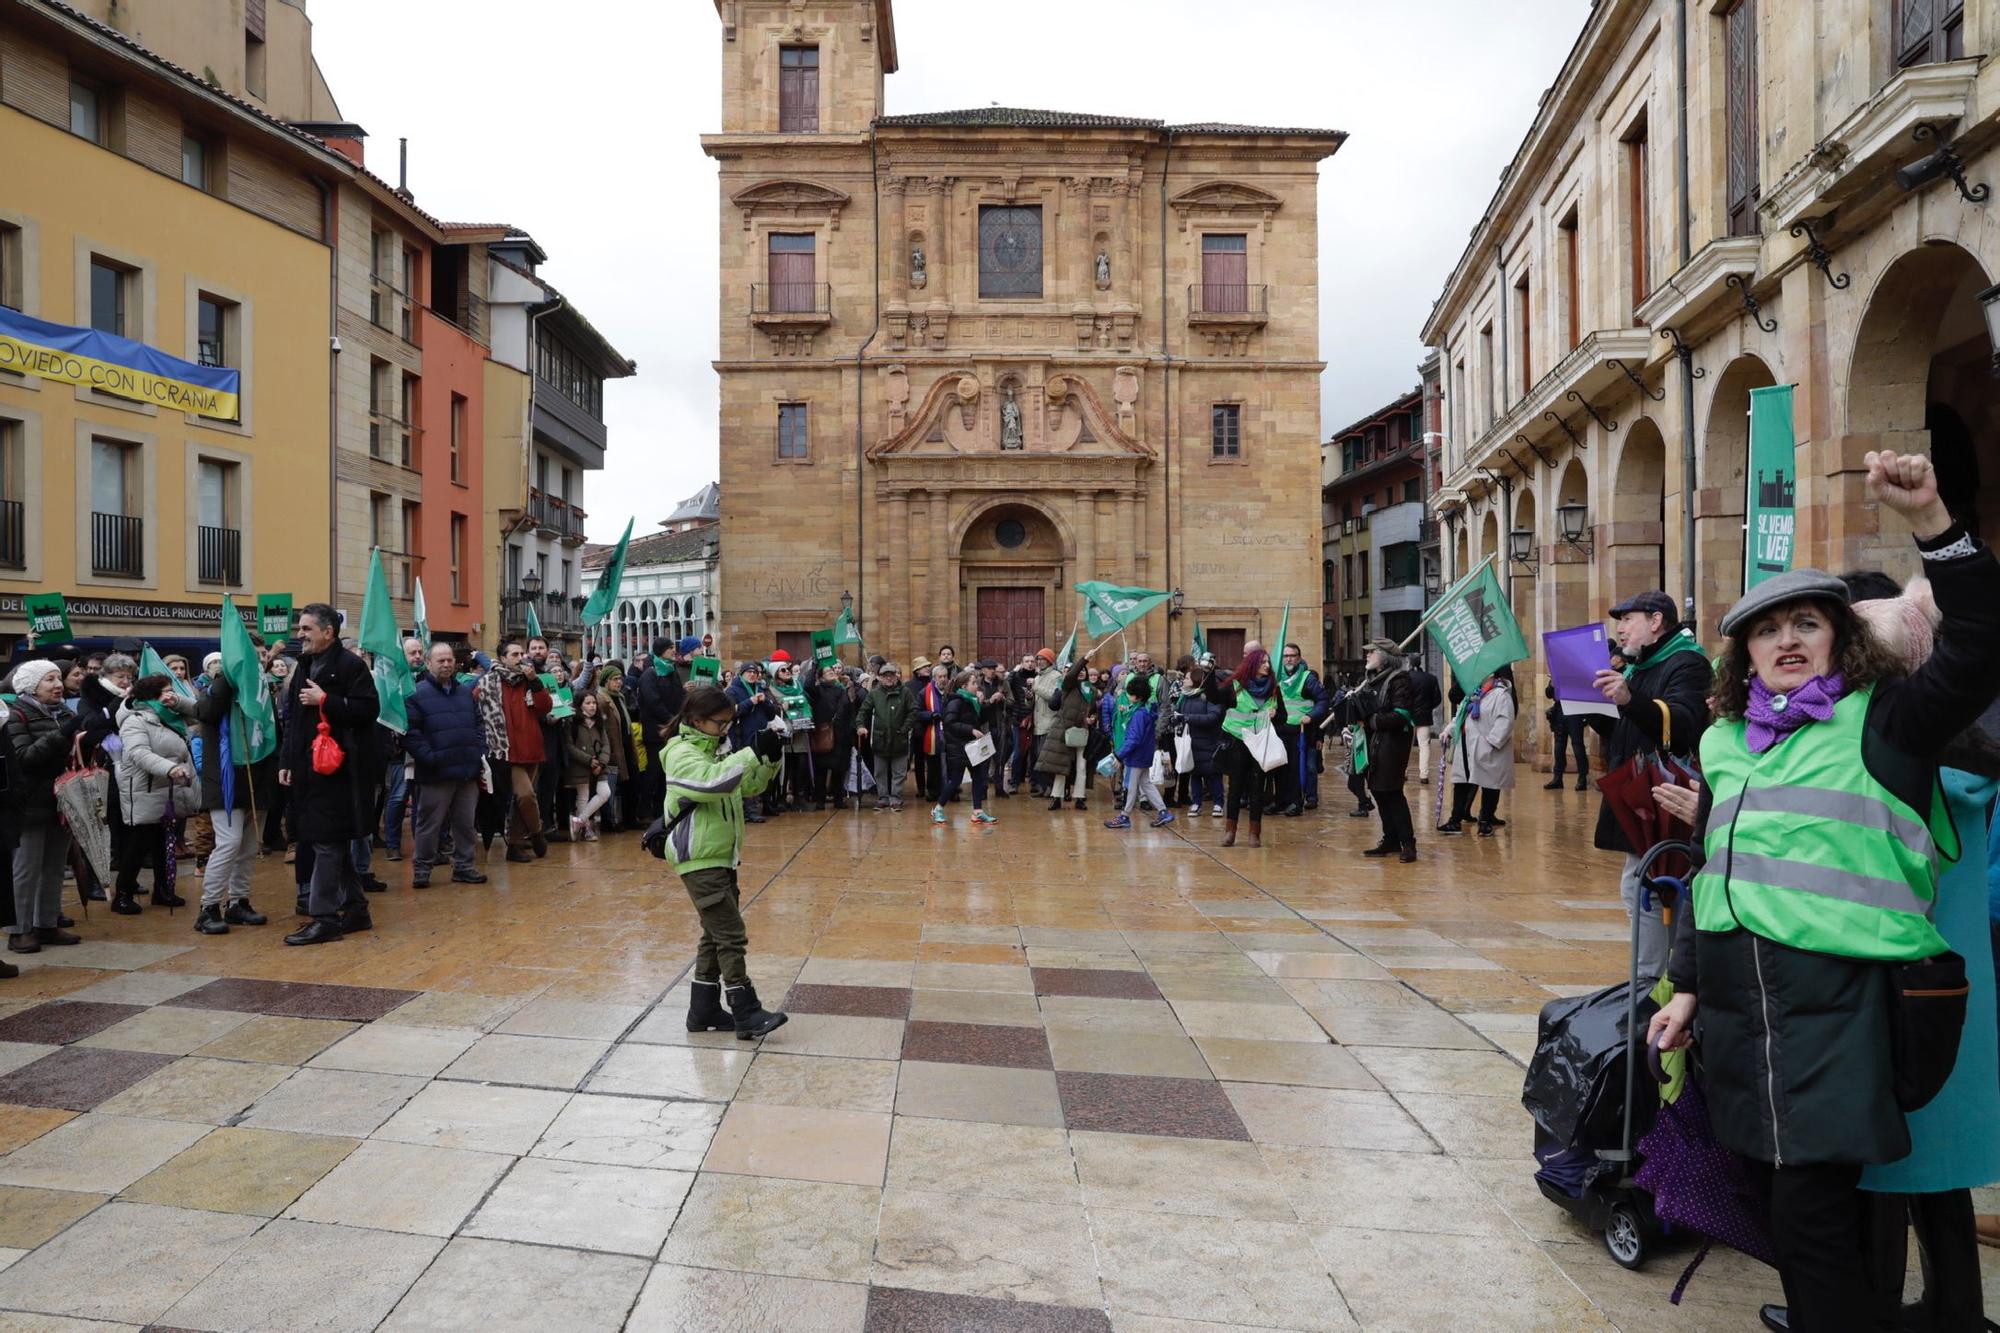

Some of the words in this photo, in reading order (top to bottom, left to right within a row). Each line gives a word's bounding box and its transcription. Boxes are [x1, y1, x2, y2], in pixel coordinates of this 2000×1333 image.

[0, 342, 82, 379] OVIEDO
[90, 364, 135, 392] CON
[142, 379, 218, 413] UCRANIA
[1766, 535, 1789, 561] VEG
[2, 600, 18, 611] DE
[152, 607, 170, 617] DEL
[172, 607, 223, 620] PRINCIPADO
[1434, 607, 1455, 632] LA
[1446, 624, 1474, 664] VEGA
